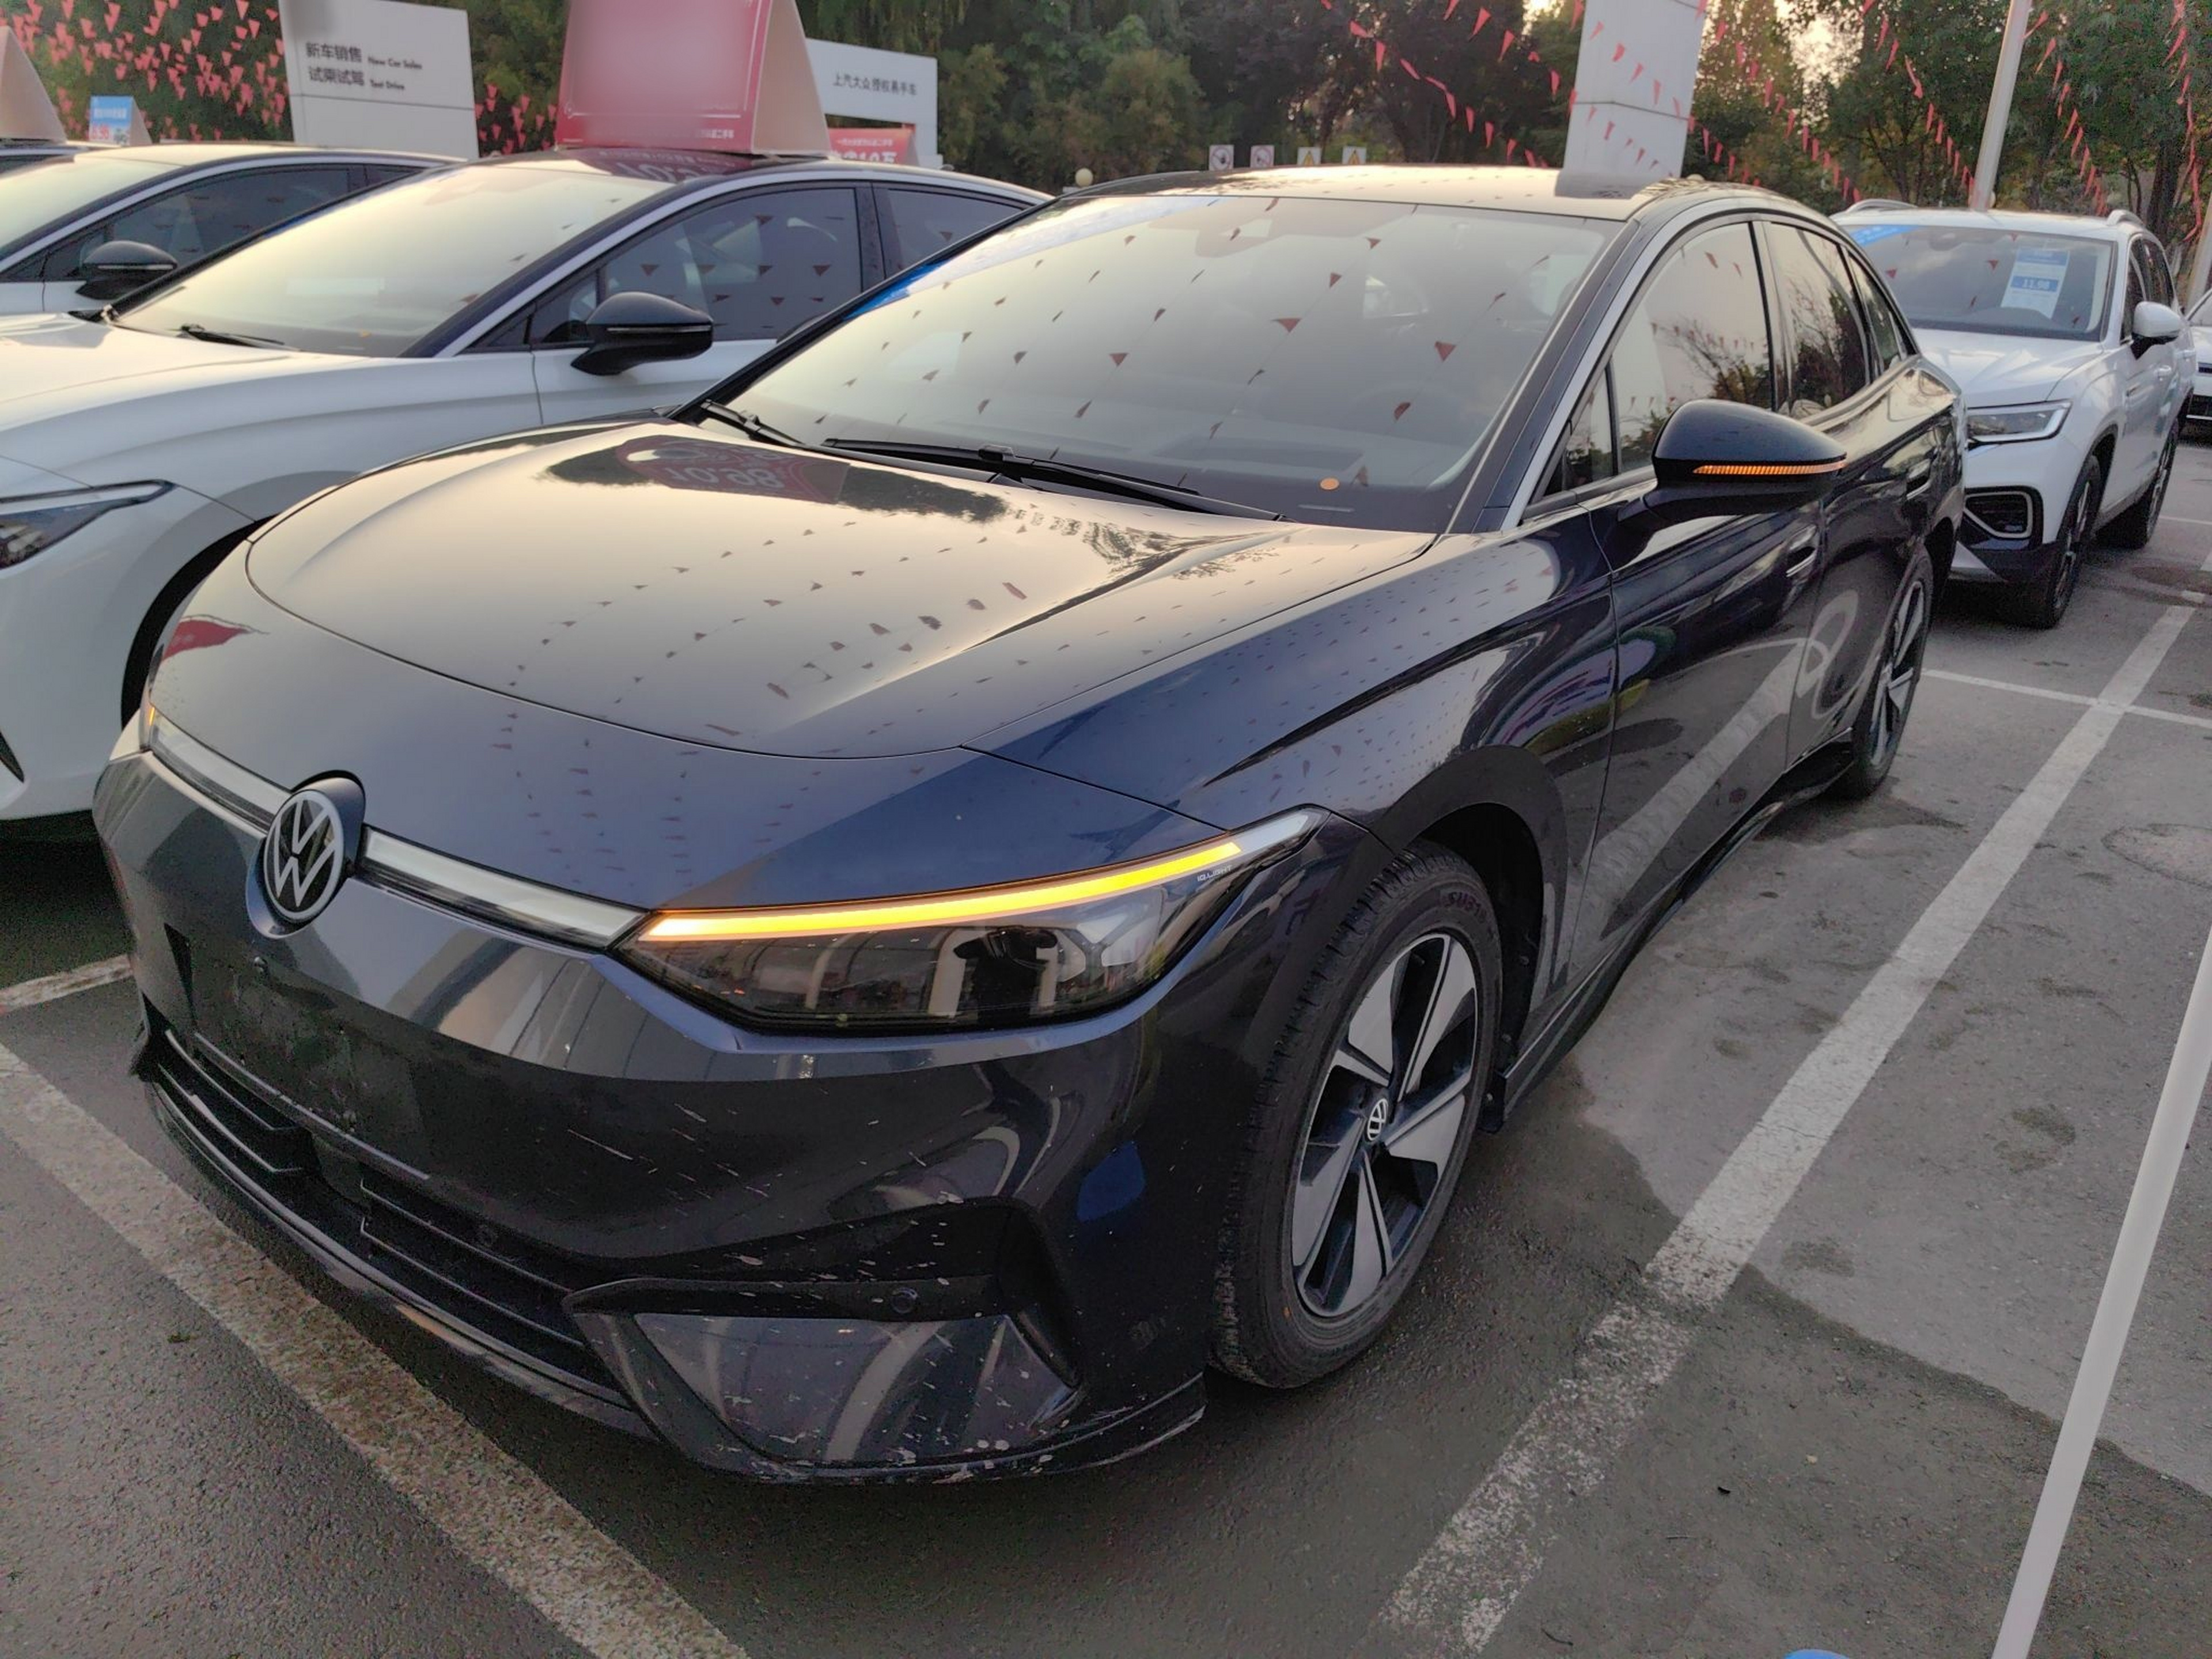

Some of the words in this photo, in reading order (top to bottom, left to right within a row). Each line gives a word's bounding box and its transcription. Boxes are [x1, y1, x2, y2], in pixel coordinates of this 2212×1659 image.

[305, 41, 362, 63] 新车销售
[308, 66, 365, 86] 试乘试驾
[266, 791, 341, 916] VW
